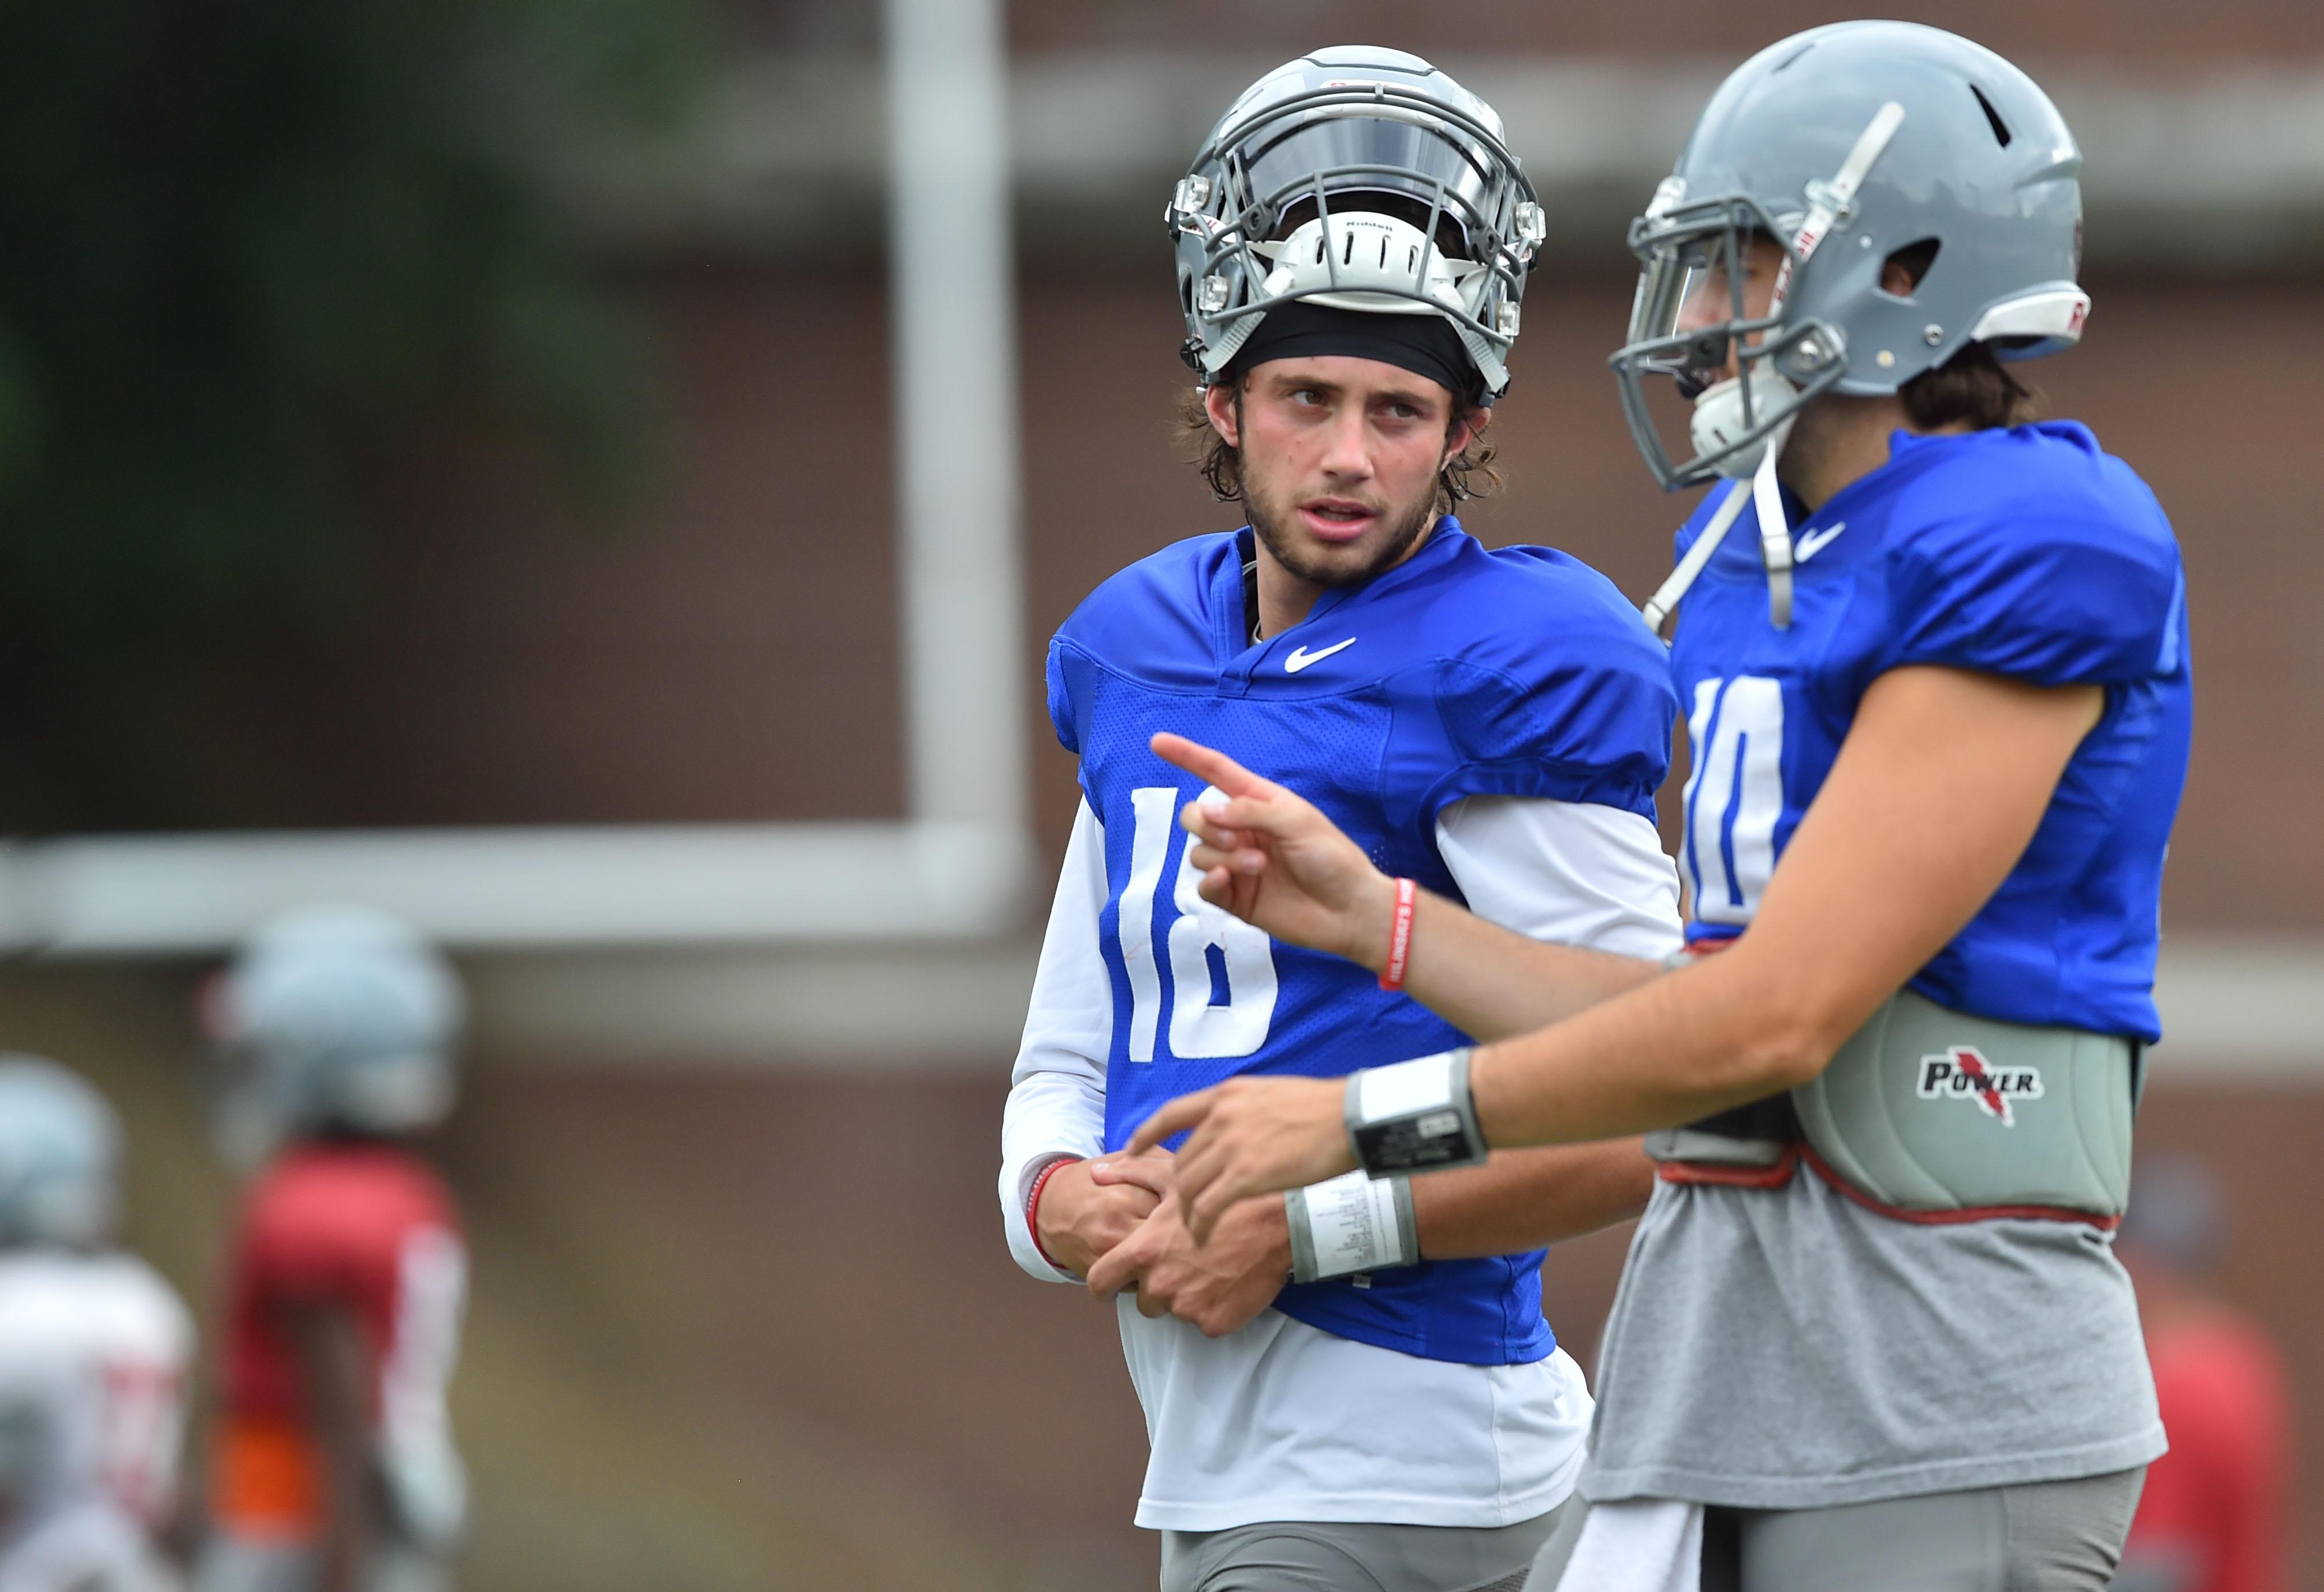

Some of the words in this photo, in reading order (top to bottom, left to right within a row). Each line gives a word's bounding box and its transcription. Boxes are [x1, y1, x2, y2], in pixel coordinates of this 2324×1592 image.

[1119, 785, 1278, 1062] 18
[1677, 674, 1784, 924] 10
[1924, 1062, 2034, 1092] POWER
